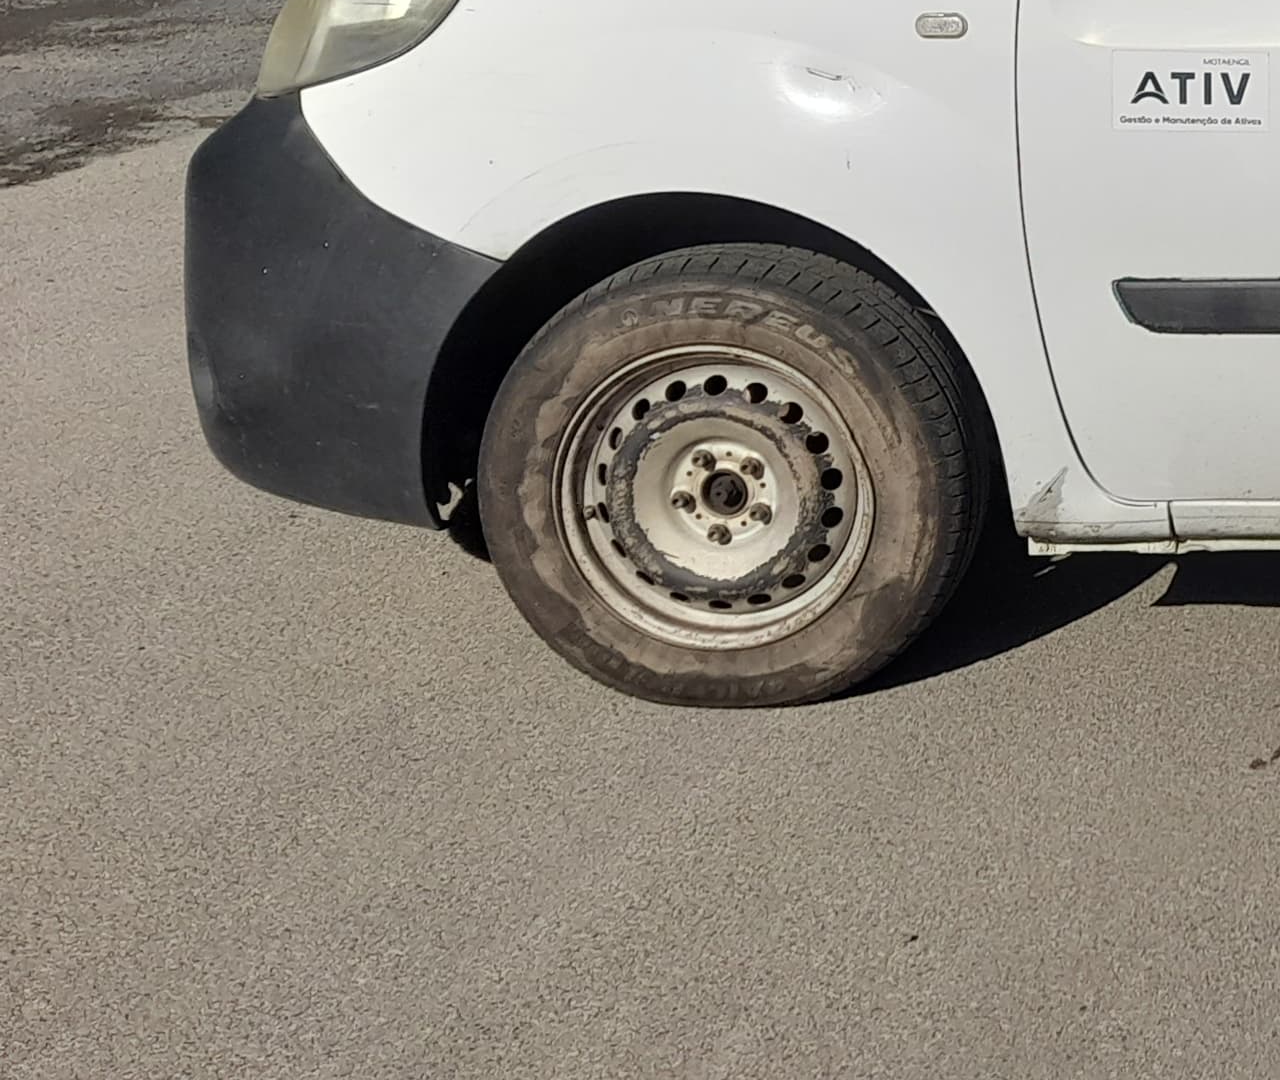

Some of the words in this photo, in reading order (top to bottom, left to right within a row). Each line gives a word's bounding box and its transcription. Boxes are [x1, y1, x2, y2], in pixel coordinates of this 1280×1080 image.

[1130, 71, 1251, 105] ATIV
[1119, 115, 1152, 124] Gestão
[652, 296, 861, 376] NEREUS
